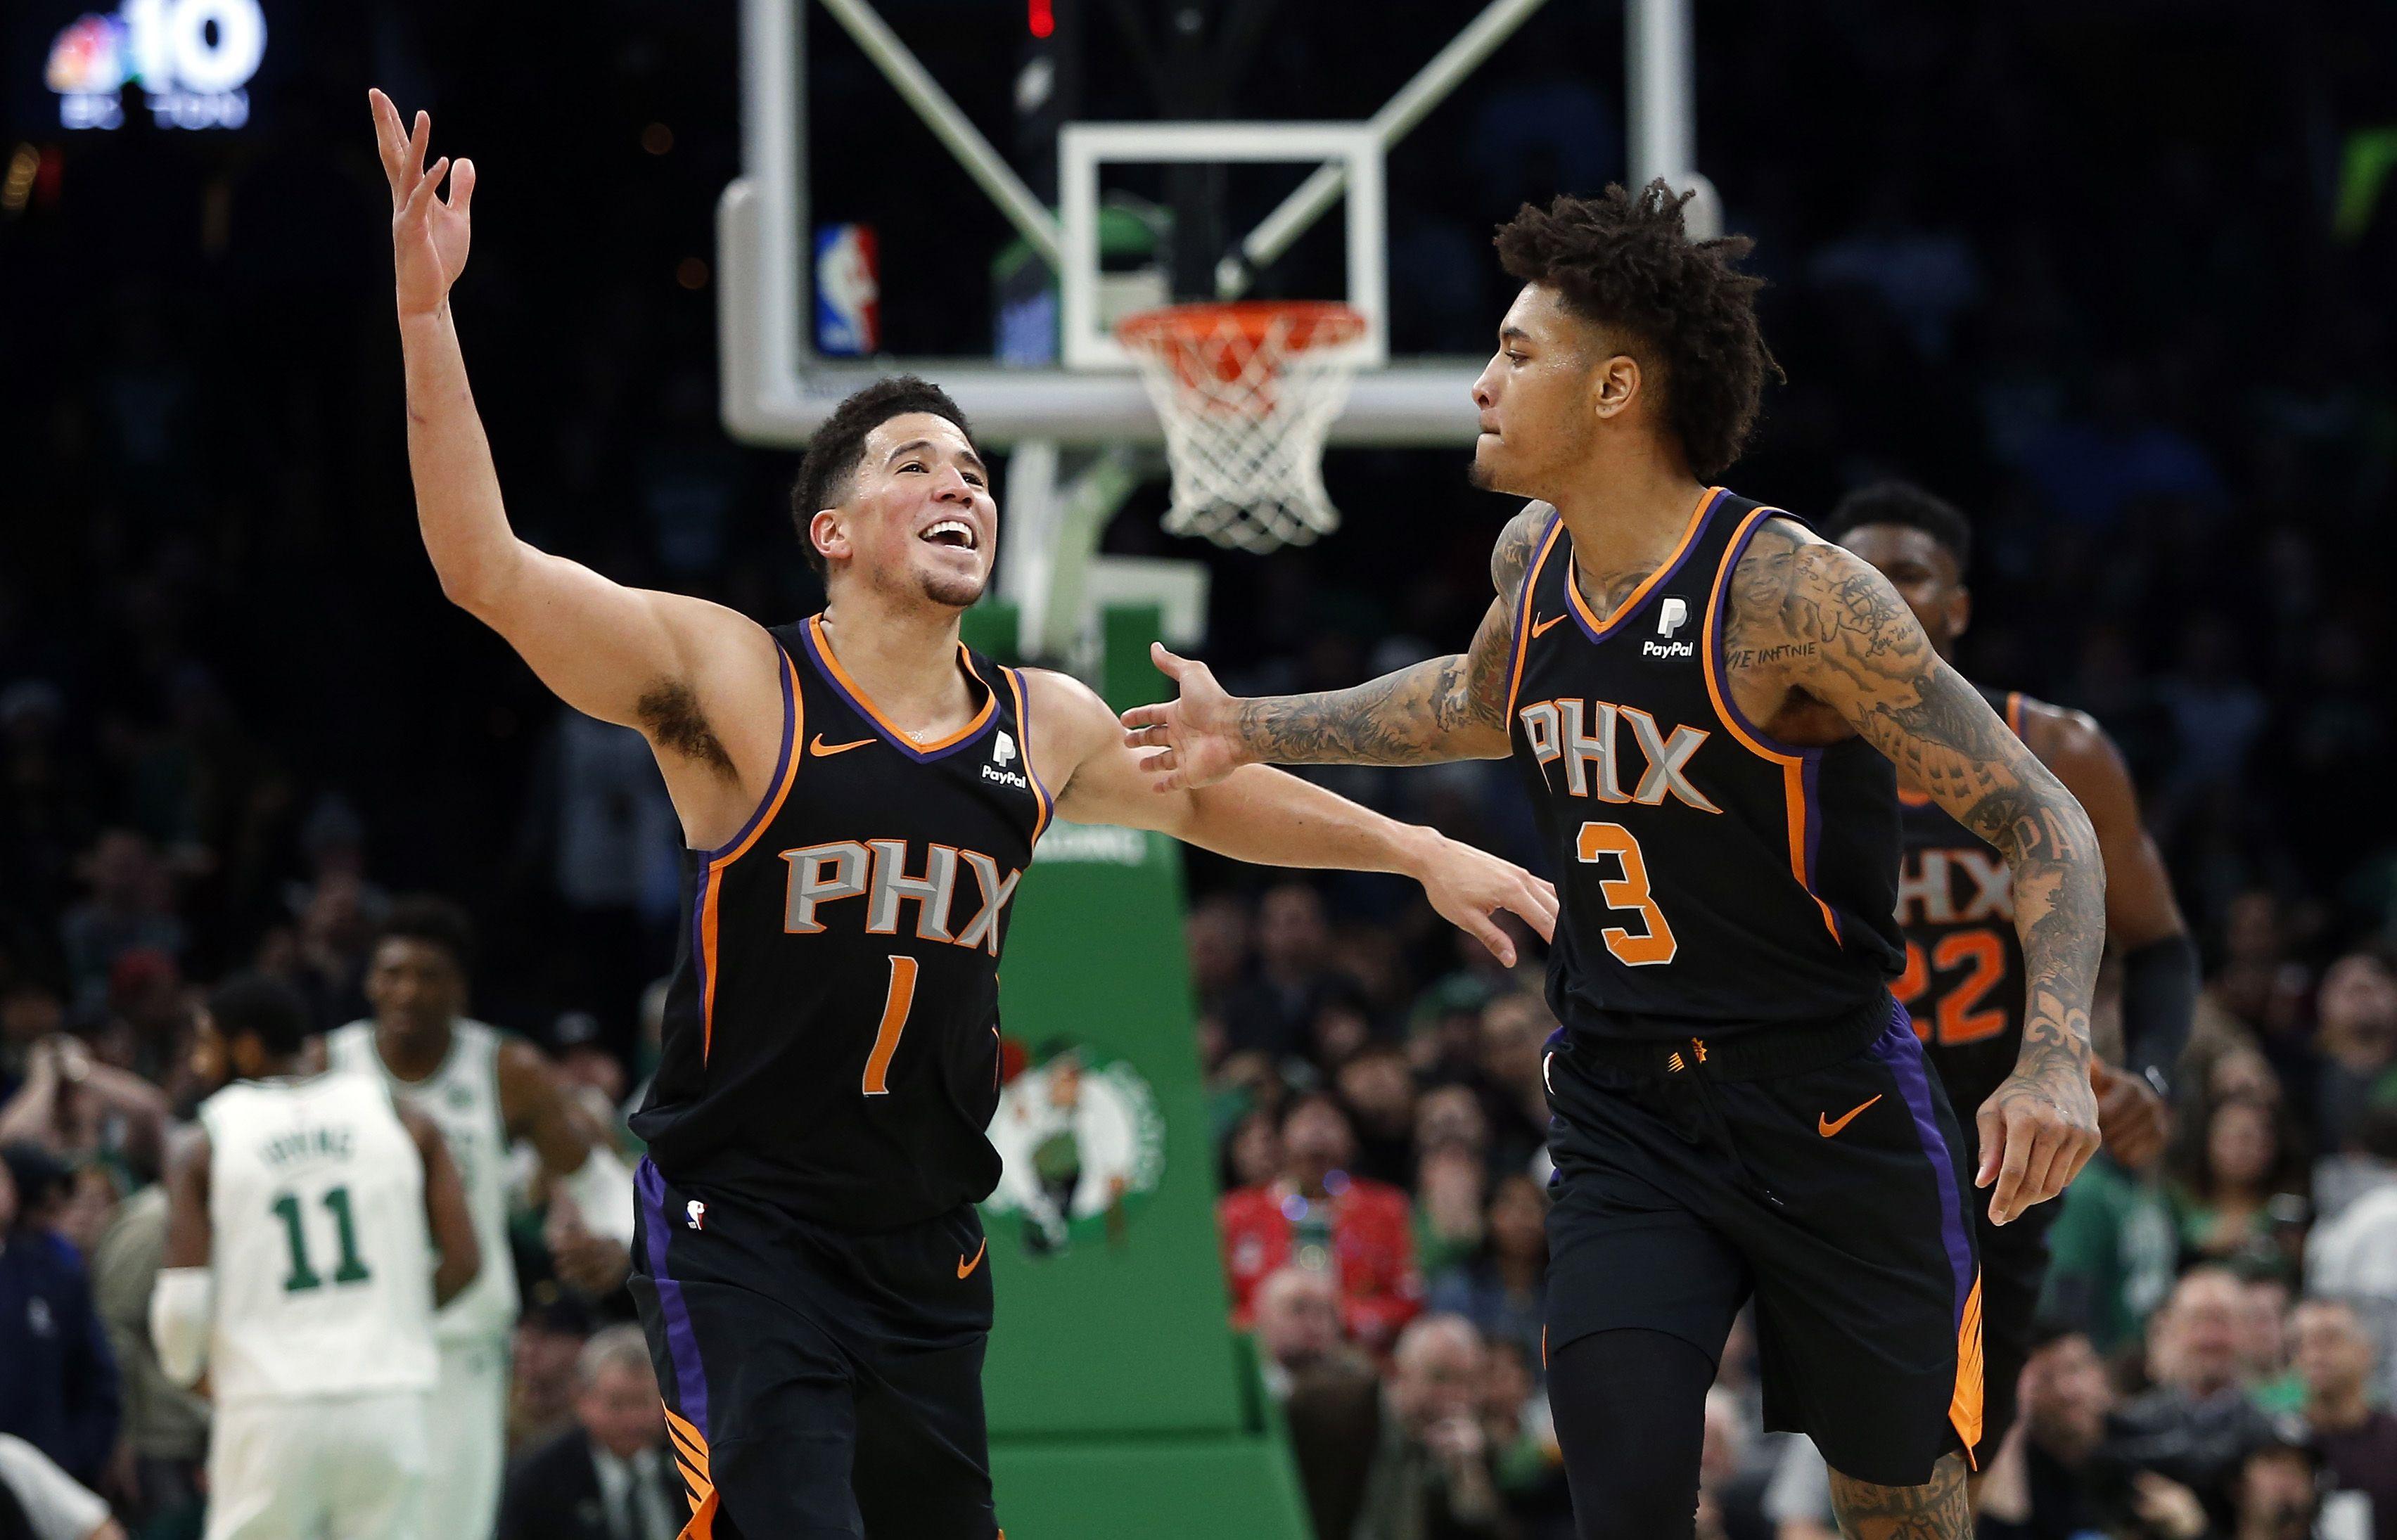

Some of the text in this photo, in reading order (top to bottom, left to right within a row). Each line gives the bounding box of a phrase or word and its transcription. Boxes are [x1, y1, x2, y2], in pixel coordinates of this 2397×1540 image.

[1642, 641, 1694, 659] PayPal
[982, 764, 1026, 788] PayPal
[1519, 698, 1724, 814] PHX
[778, 839, 1021, 957] PHX
[1576, 821, 1677, 965] 3
[1892, 847, 2014, 925] HX
[862, 955, 919, 1096] 1
[270, 1184, 372, 1292] 11
